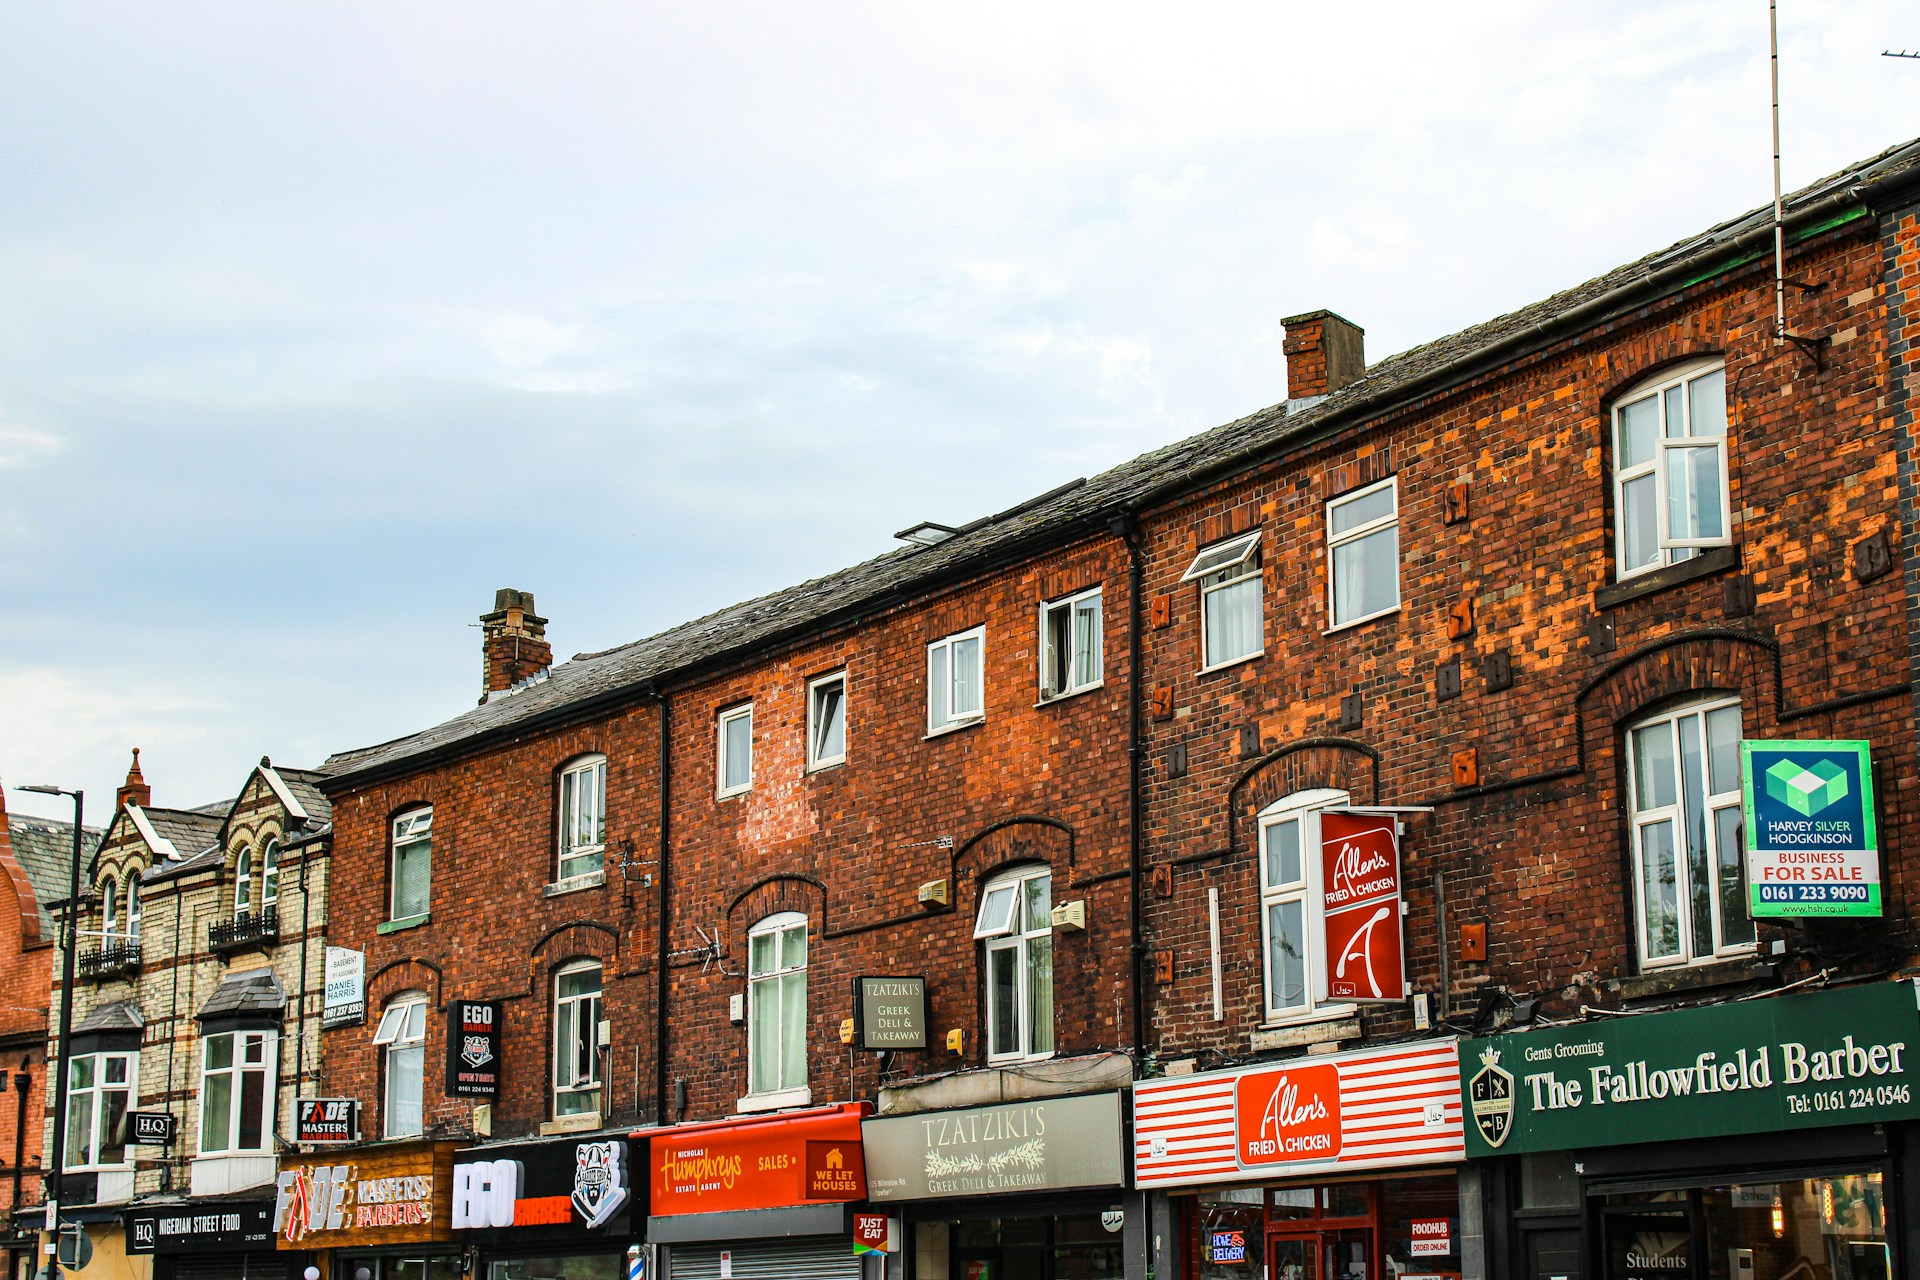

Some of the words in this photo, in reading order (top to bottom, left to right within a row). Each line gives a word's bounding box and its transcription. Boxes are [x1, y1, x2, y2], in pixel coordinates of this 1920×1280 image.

[1769, 821, 1813, 831] HARVEY
[1815, 822, 1850, 831] SILVER
[1769, 834, 1852, 844] HODGKINSON
[1779, 853, 1844, 863] BUSINESS
[1334, 842, 1387, 897] Allen's
[1764, 867, 1805, 880] FOR
[1811, 867, 1862, 880] SALE
[1325, 889, 1349, 904] FRIED
[1357, 877, 1394, 896] CHICKEN
[1762, 886, 1793, 900] 0161
[1799, 886, 1826, 900] 233
[1830, 886, 1866, 900] 9090
[1782, 905, 1848, 913] www.hsh.co.uk
[334, 956, 357, 968] BASEMENT
[328, 980, 356, 992] DANIEL
[866, 984, 920, 996] TZATZIKI'S
[328, 988, 356, 1000] HARRIS
[324, 1007, 336, 1019] 0161
[337, 1005, 348, 1016] 237
[463, 1005, 492, 1024] EGO
[878, 1006, 910, 1015] GREEK
[463, 1023, 492, 1032] BARBER
[878, 1019, 900, 1028] DELI
[904, 1018, 912, 1028] &
[871, 1031, 920, 1040] TAKEAWAY
[1525, 1046, 1552, 1062] Gents
[1554, 1039, 1604, 1058] Grooming
[458, 1073, 474, 1082] OPEN
[475, 1073, 479, 1082] 7
[479, 1073, 494, 1082] DAYS
[1524, 1071, 1582, 1111] The
[1588, 1046, 1772, 1104] Fallowfield
[1780, 1035, 1905, 1085] Barber
[1476, 1083, 1484, 1098] F
[1787, 1094, 1811, 1114] Tel:
[1815, 1090, 1845, 1112] 0161
[1850, 1088, 1874, 1108] 224
[1877, 1084, 1910, 1104] 0546
[302, 1102, 350, 1123] FADE
[1260, 1075, 1327, 1153] Allen's
[303, 1124, 348, 1132] MASTERS
[922, 1107, 1045, 1147] TZATZIKI'S
[1495, 1116, 1503, 1130] B
[302, 1132, 348, 1140] BARBERS
[1249, 1140, 1276, 1156] FRIED
[1286, 1134, 1330, 1152] CHICKEN
[678, 1149, 704, 1158] NICHOLAS
[759, 1154, 789, 1171] SALES
[661, 1148, 741, 1196] Humphreys
[816, 1170, 832, 1180] WE
[836, 1170, 853, 1180] LET
[676, 1184, 696, 1193] ESTATE
[700, 1182, 721, 1191] AGENT
[813, 1181, 856, 1190] HOUSES
[928, 1180, 959, 1193] GREEK
[962, 1178, 984, 1191] DELI
[987, 1175, 995, 1188] &
[998, 1172, 1047, 1187] TAKEAWAY
[357, 1176, 423, 1204] MASTERS
[452, 1159, 518, 1229] EGO
[273, 1165, 350, 1242] FADE
[356, 1202, 423, 1227] BARBERS
[513, 1196, 572, 1226] BARBER
[159, 1217, 191, 1235] NIGERIAN
[194, 1216, 220, 1233] STREET
[222, 1214, 240, 1231] FOOD
[859, 1218, 883, 1229] JUST
[1412, 1222, 1447, 1235] FOODHUB
[864, 1229, 883, 1238] EAT
[1213, 1234, 1231, 1247] HOME
[1213, 1247, 1245, 1261] DELIVERY
[1627, 1252, 1686, 1268] Students
